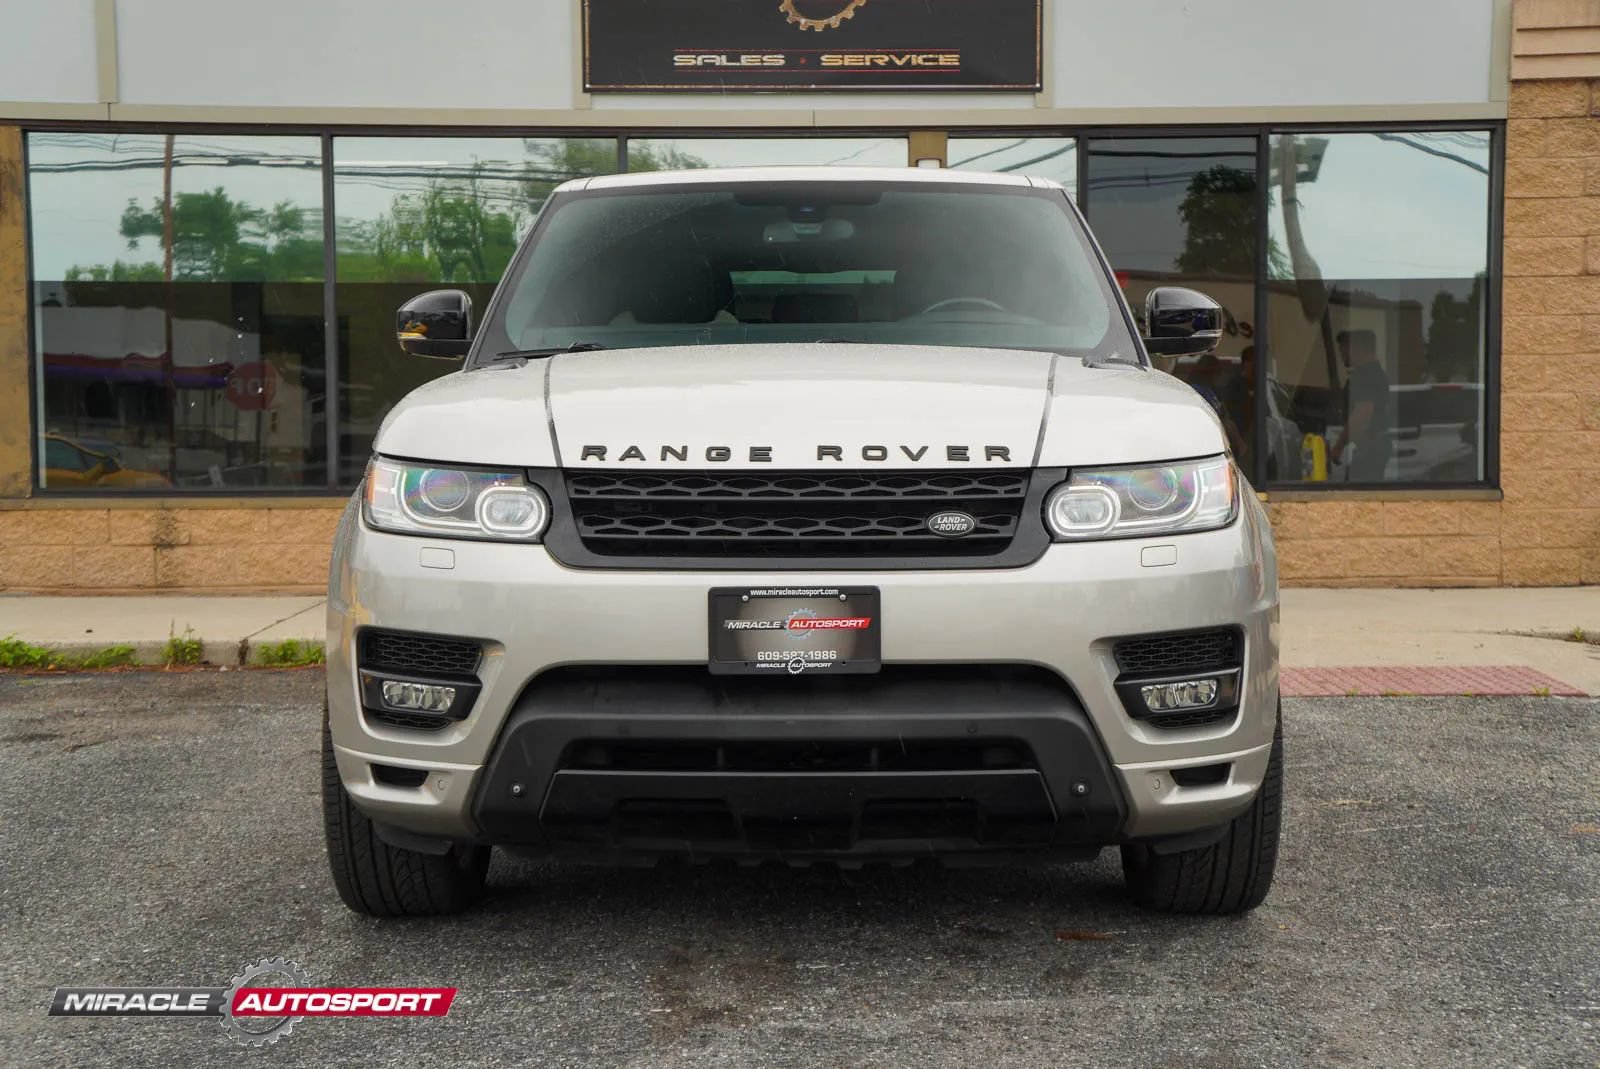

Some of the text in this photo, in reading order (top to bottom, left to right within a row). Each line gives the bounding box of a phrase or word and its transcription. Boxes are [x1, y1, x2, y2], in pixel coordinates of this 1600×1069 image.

[673, 54, 961, 66] SALES SERVICE
[581, 445, 1012, 462] RANGE ROVER
[750, 588, 839, 597] www.miracleautosport.com
[727, 618, 866, 630] MIRACLE AUTOSPORT
[757, 650, 837, 661] 609-587-1986
